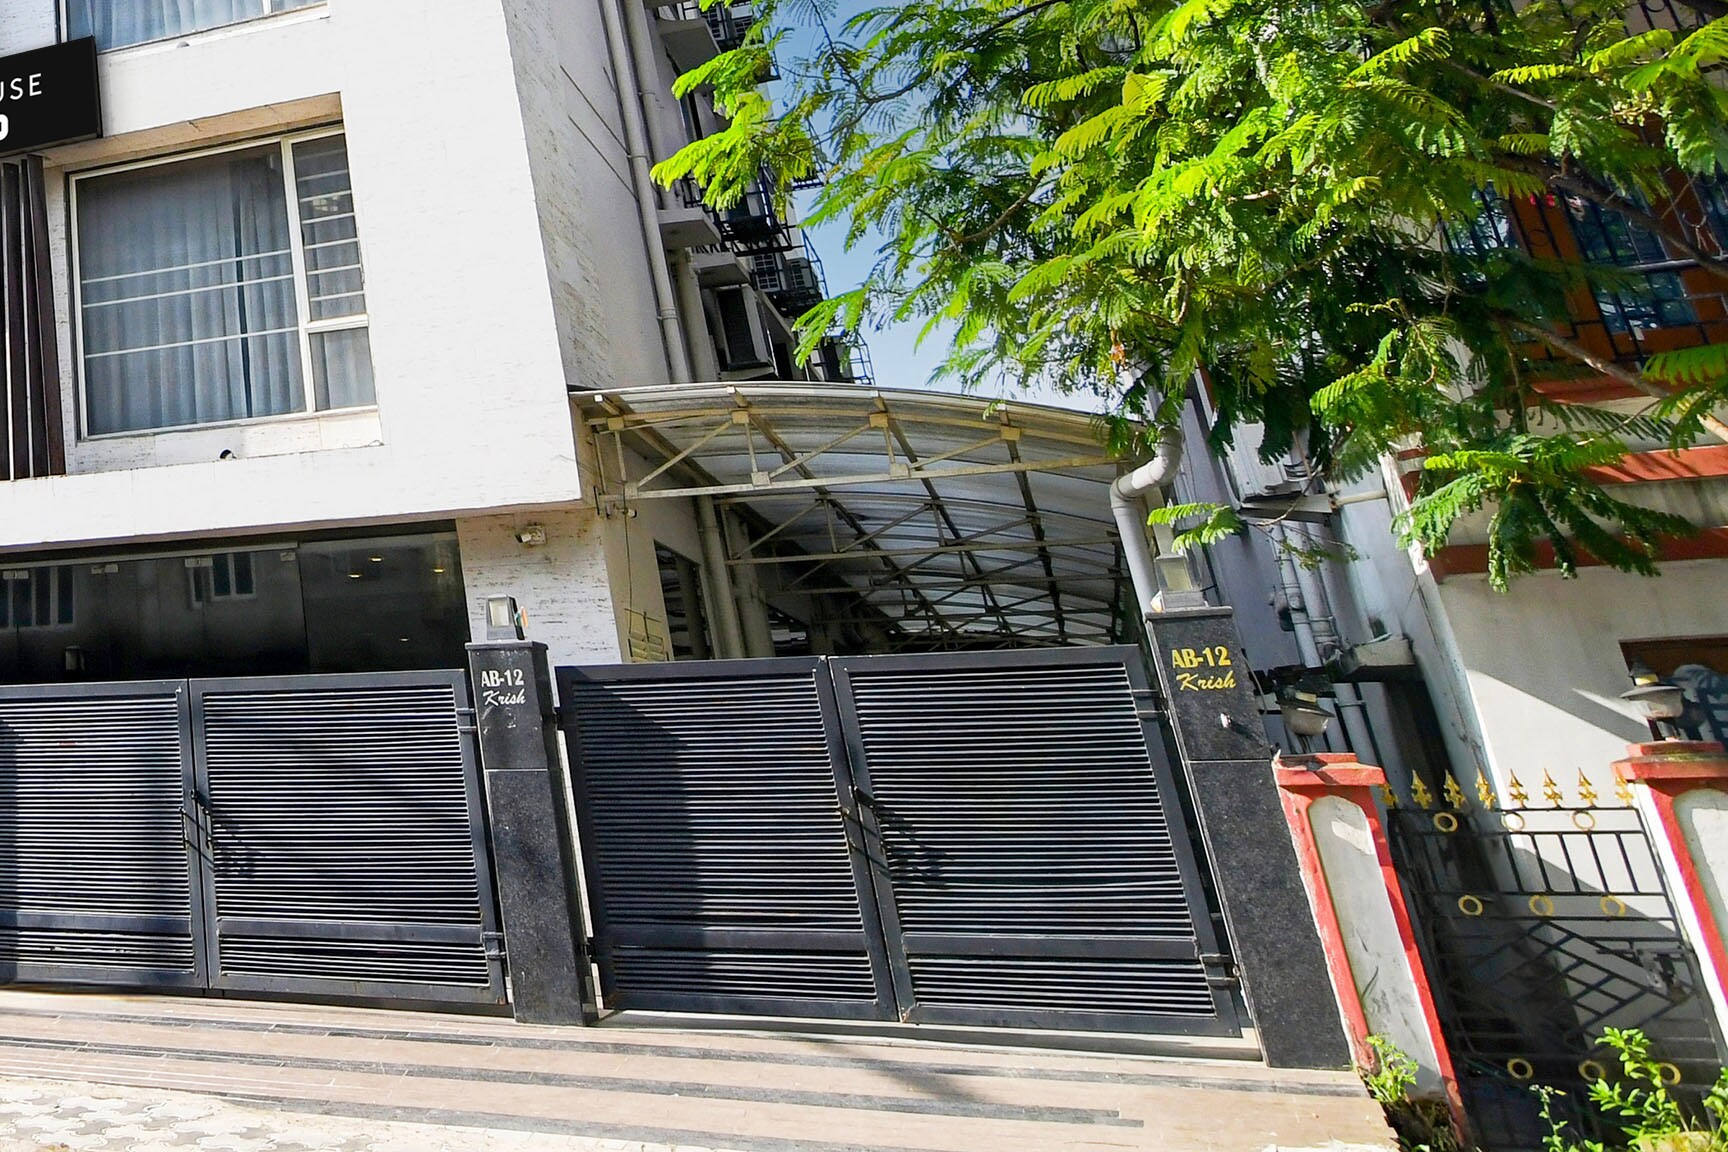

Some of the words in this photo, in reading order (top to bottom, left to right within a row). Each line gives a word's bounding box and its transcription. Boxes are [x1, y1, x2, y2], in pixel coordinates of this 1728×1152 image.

[1172, 646, 1232, 669] AB-12
[481, 669, 525, 687] AB-12
[1176, 670, 1237, 692] Krish
[482, 688, 526, 707] Krish
